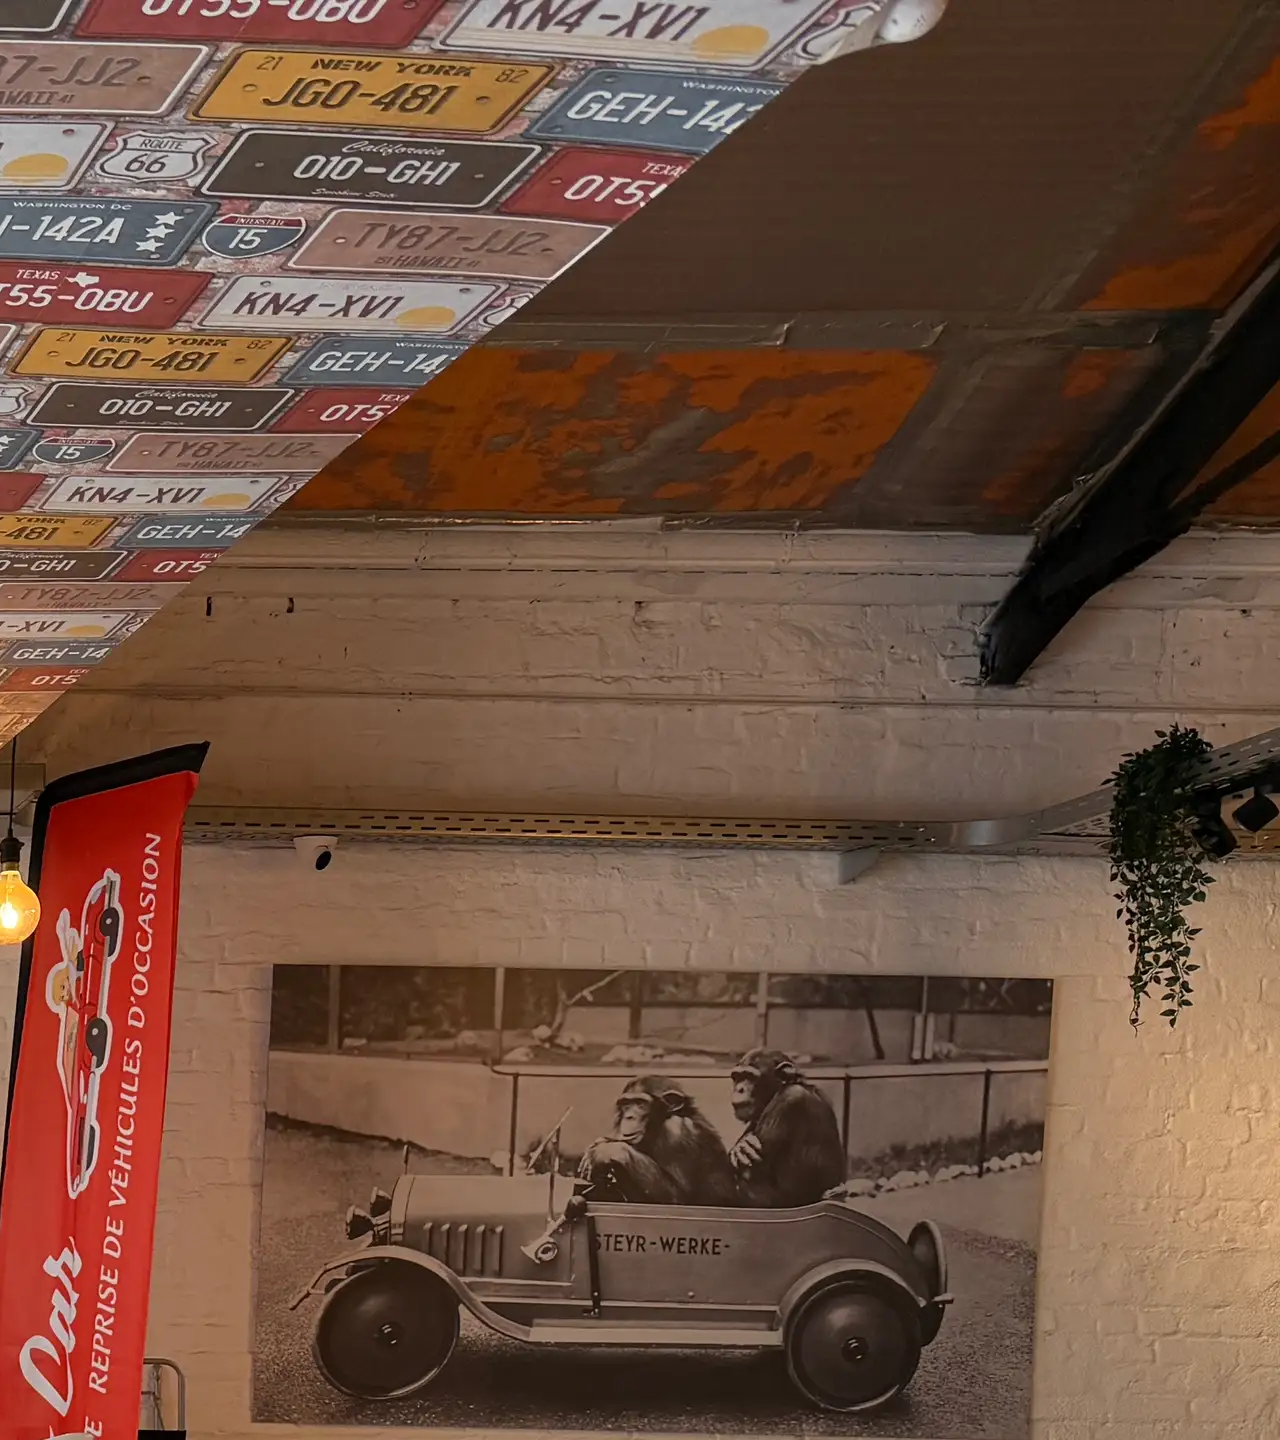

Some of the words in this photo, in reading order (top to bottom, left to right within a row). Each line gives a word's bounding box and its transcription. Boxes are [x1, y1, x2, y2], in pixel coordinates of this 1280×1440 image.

[311, 58, 388, 75] NEW
[395, 62, 476, 78] YORK
[263, 82, 457, 114] JGO-481
[139, 139, 181, 151] ROUTE
[342, 139, 446, 157] California
[123, 154, 168, 175] 66
[228, 228, 269, 249] 15
[127, 832, 162, 1029] D'OCCASION
[107, 1037, 143, 1209] VÉHICULES
[102, 1215, 125, 1261] DE
[18, 1235, 83, 1418] Car
[88, 1267, 119, 1395] REPRISE
